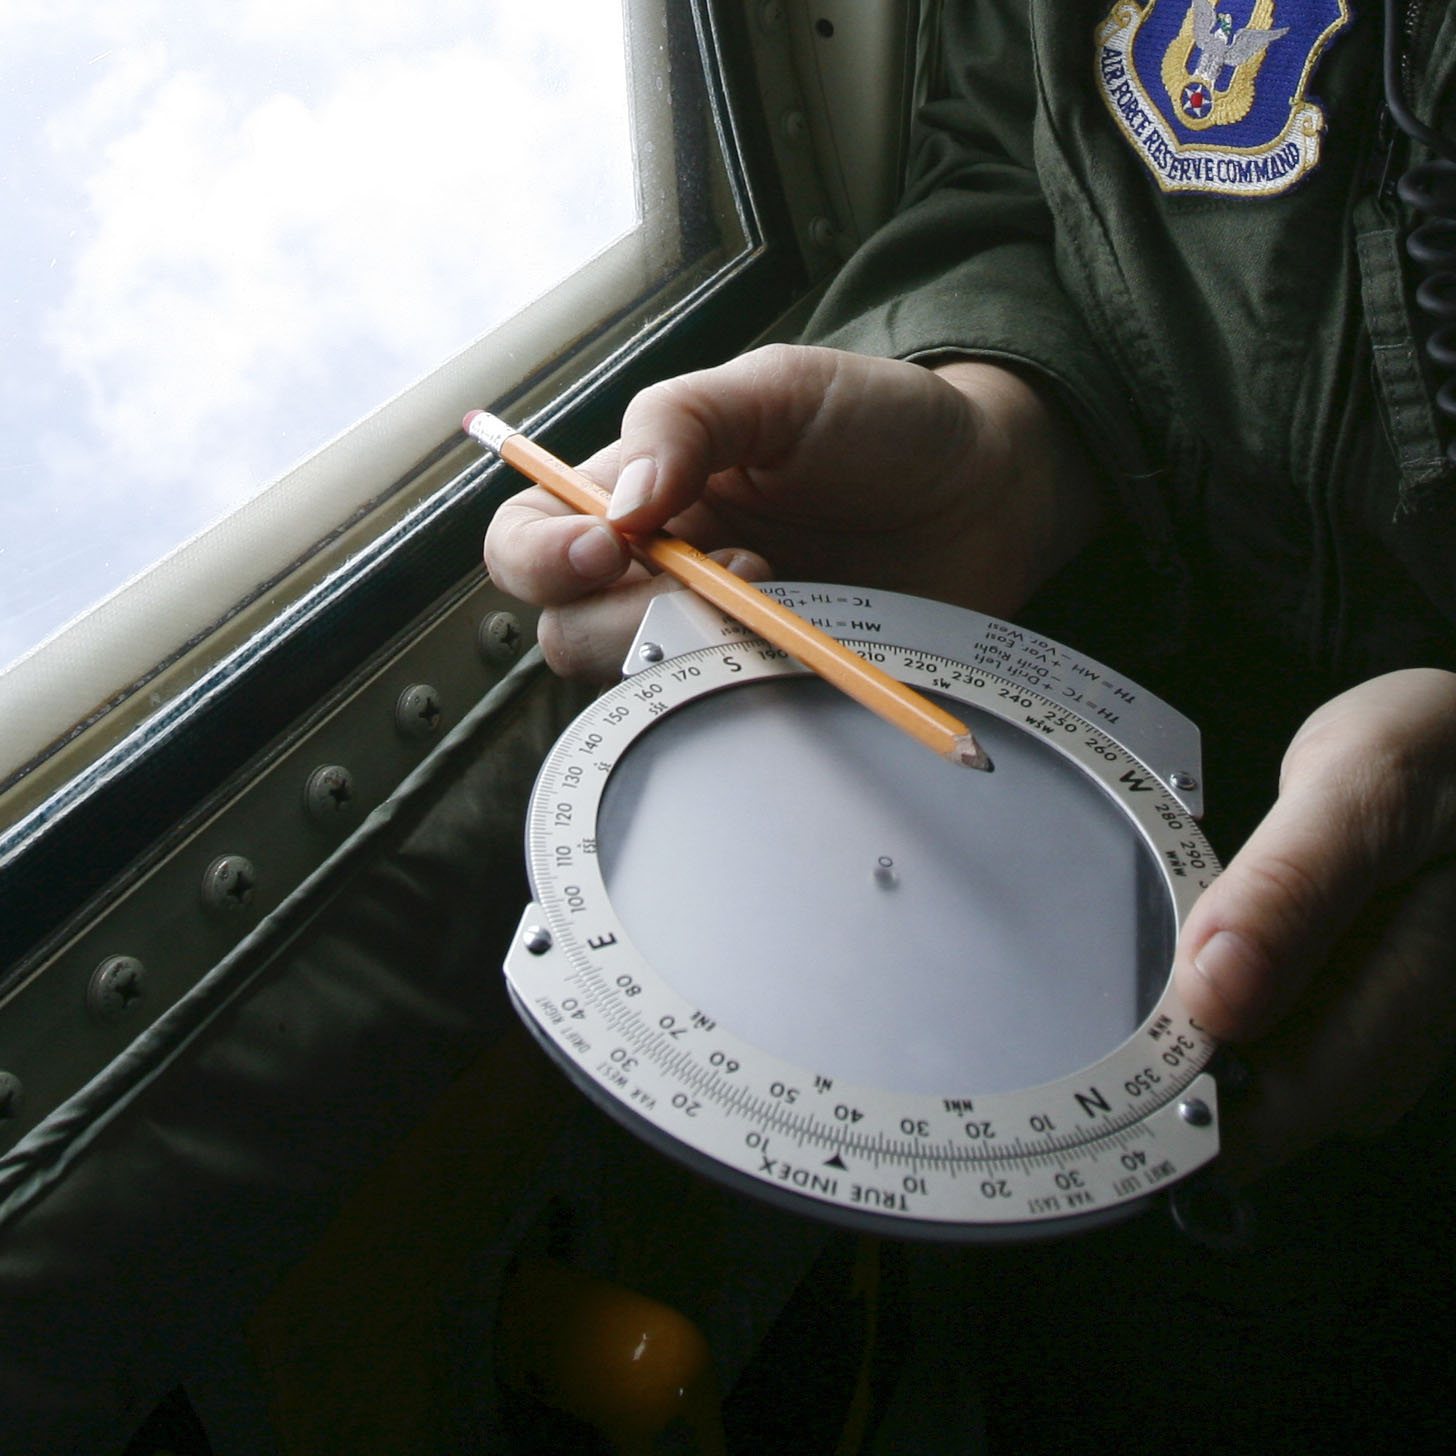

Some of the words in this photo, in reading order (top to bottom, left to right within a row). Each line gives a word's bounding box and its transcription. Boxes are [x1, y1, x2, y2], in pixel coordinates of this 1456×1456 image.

[1101, 47, 1120, 85] AIR
[1113, 81, 1152, 139] FORCE
[1143, 133, 1214, 181] RESERVE
[1216, 141, 1301, 184] COMMAND
[811, 594, 832, 604] TH
[853, 597, 873, 607] TC
[811, 618, 832, 628] TH
[852, 620, 881, 632] MH
[987, 622, 1023, 639] West
[985, 632, 1015, 648] East
[857, 650, 885, 663] 210
[974, 641, 1011, 661] Right
[974, 652, 1001, 670] Left
[723, 656, 742, 673] S
[904, 658, 937, 673] 220
[1017, 658, 1049, 678] Drift
[1072, 663, 1100, 681] MH
[671, 666, 701, 684] 170
[952, 671, 985, 688] 230
[1007, 665, 1041, 685] Drift
[634, 683, 663, 702] 160
[997, 688, 1033, 708] 240
[1062, 687, 1084, 704] TC
[1113, 688, 1136, 705] TH
[603, 706, 630, 726] 150
[1043, 711, 1078, 733] 250
[1097, 707, 1120, 724] TH
[579, 733, 603, 755] 140
[1085, 738, 1117, 762] 260
[562, 766, 583, 789] 130
[1119, 770, 1153, 792] W
[555, 802, 573, 826] 120
[1155, 803, 1182, 830] 280
[556, 846, 573, 867] 110
[1180, 841, 1206, 869] 290
[564, 886, 586, 913] 100
[587, 932, 617, 951] E
[616, 974, 642, 997] 80
[535, 996, 565, 1025] RIGHT
[561, 999, 586, 1020] 40
[659, 1015, 688, 1040] 70
[560, 1025, 591, 1054] DRIFT
[610, 1048, 639, 1072] 30
[1162, 1035, 1194, 1067] 340
[709, 1051, 740, 1074] 60
[596, 1062, 628, 1089] WEST
[1124, 1068, 1161, 1096] 350
[630, 1089, 657, 1110] VAR
[770, 1082, 800, 1104] 50
[1074, 1087, 1112, 1118] N
[672, 1093, 702, 1117] 20
[834, 1104, 864, 1124] 40
[900, 1118, 930, 1137] 30
[965, 1122, 996, 1139] 20
[1029, 1114, 1056, 1132] 10
[745, 1132, 770, 1154] 10
[1120, 1150, 1146, 1171] 40
[759, 1155, 838, 1197] INDEX
[902, 1176, 930, 1195] 10
[1054, 1170, 1085, 1191] 30
[1113, 1175, 1142, 1196] LEFT
[850, 1184, 910, 1211] TRUE
[980, 1180, 1012, 1199] 20
[1065, 1190, 1095, 1207] VAR
[1027, 1197, 1061, 1215] EAST
